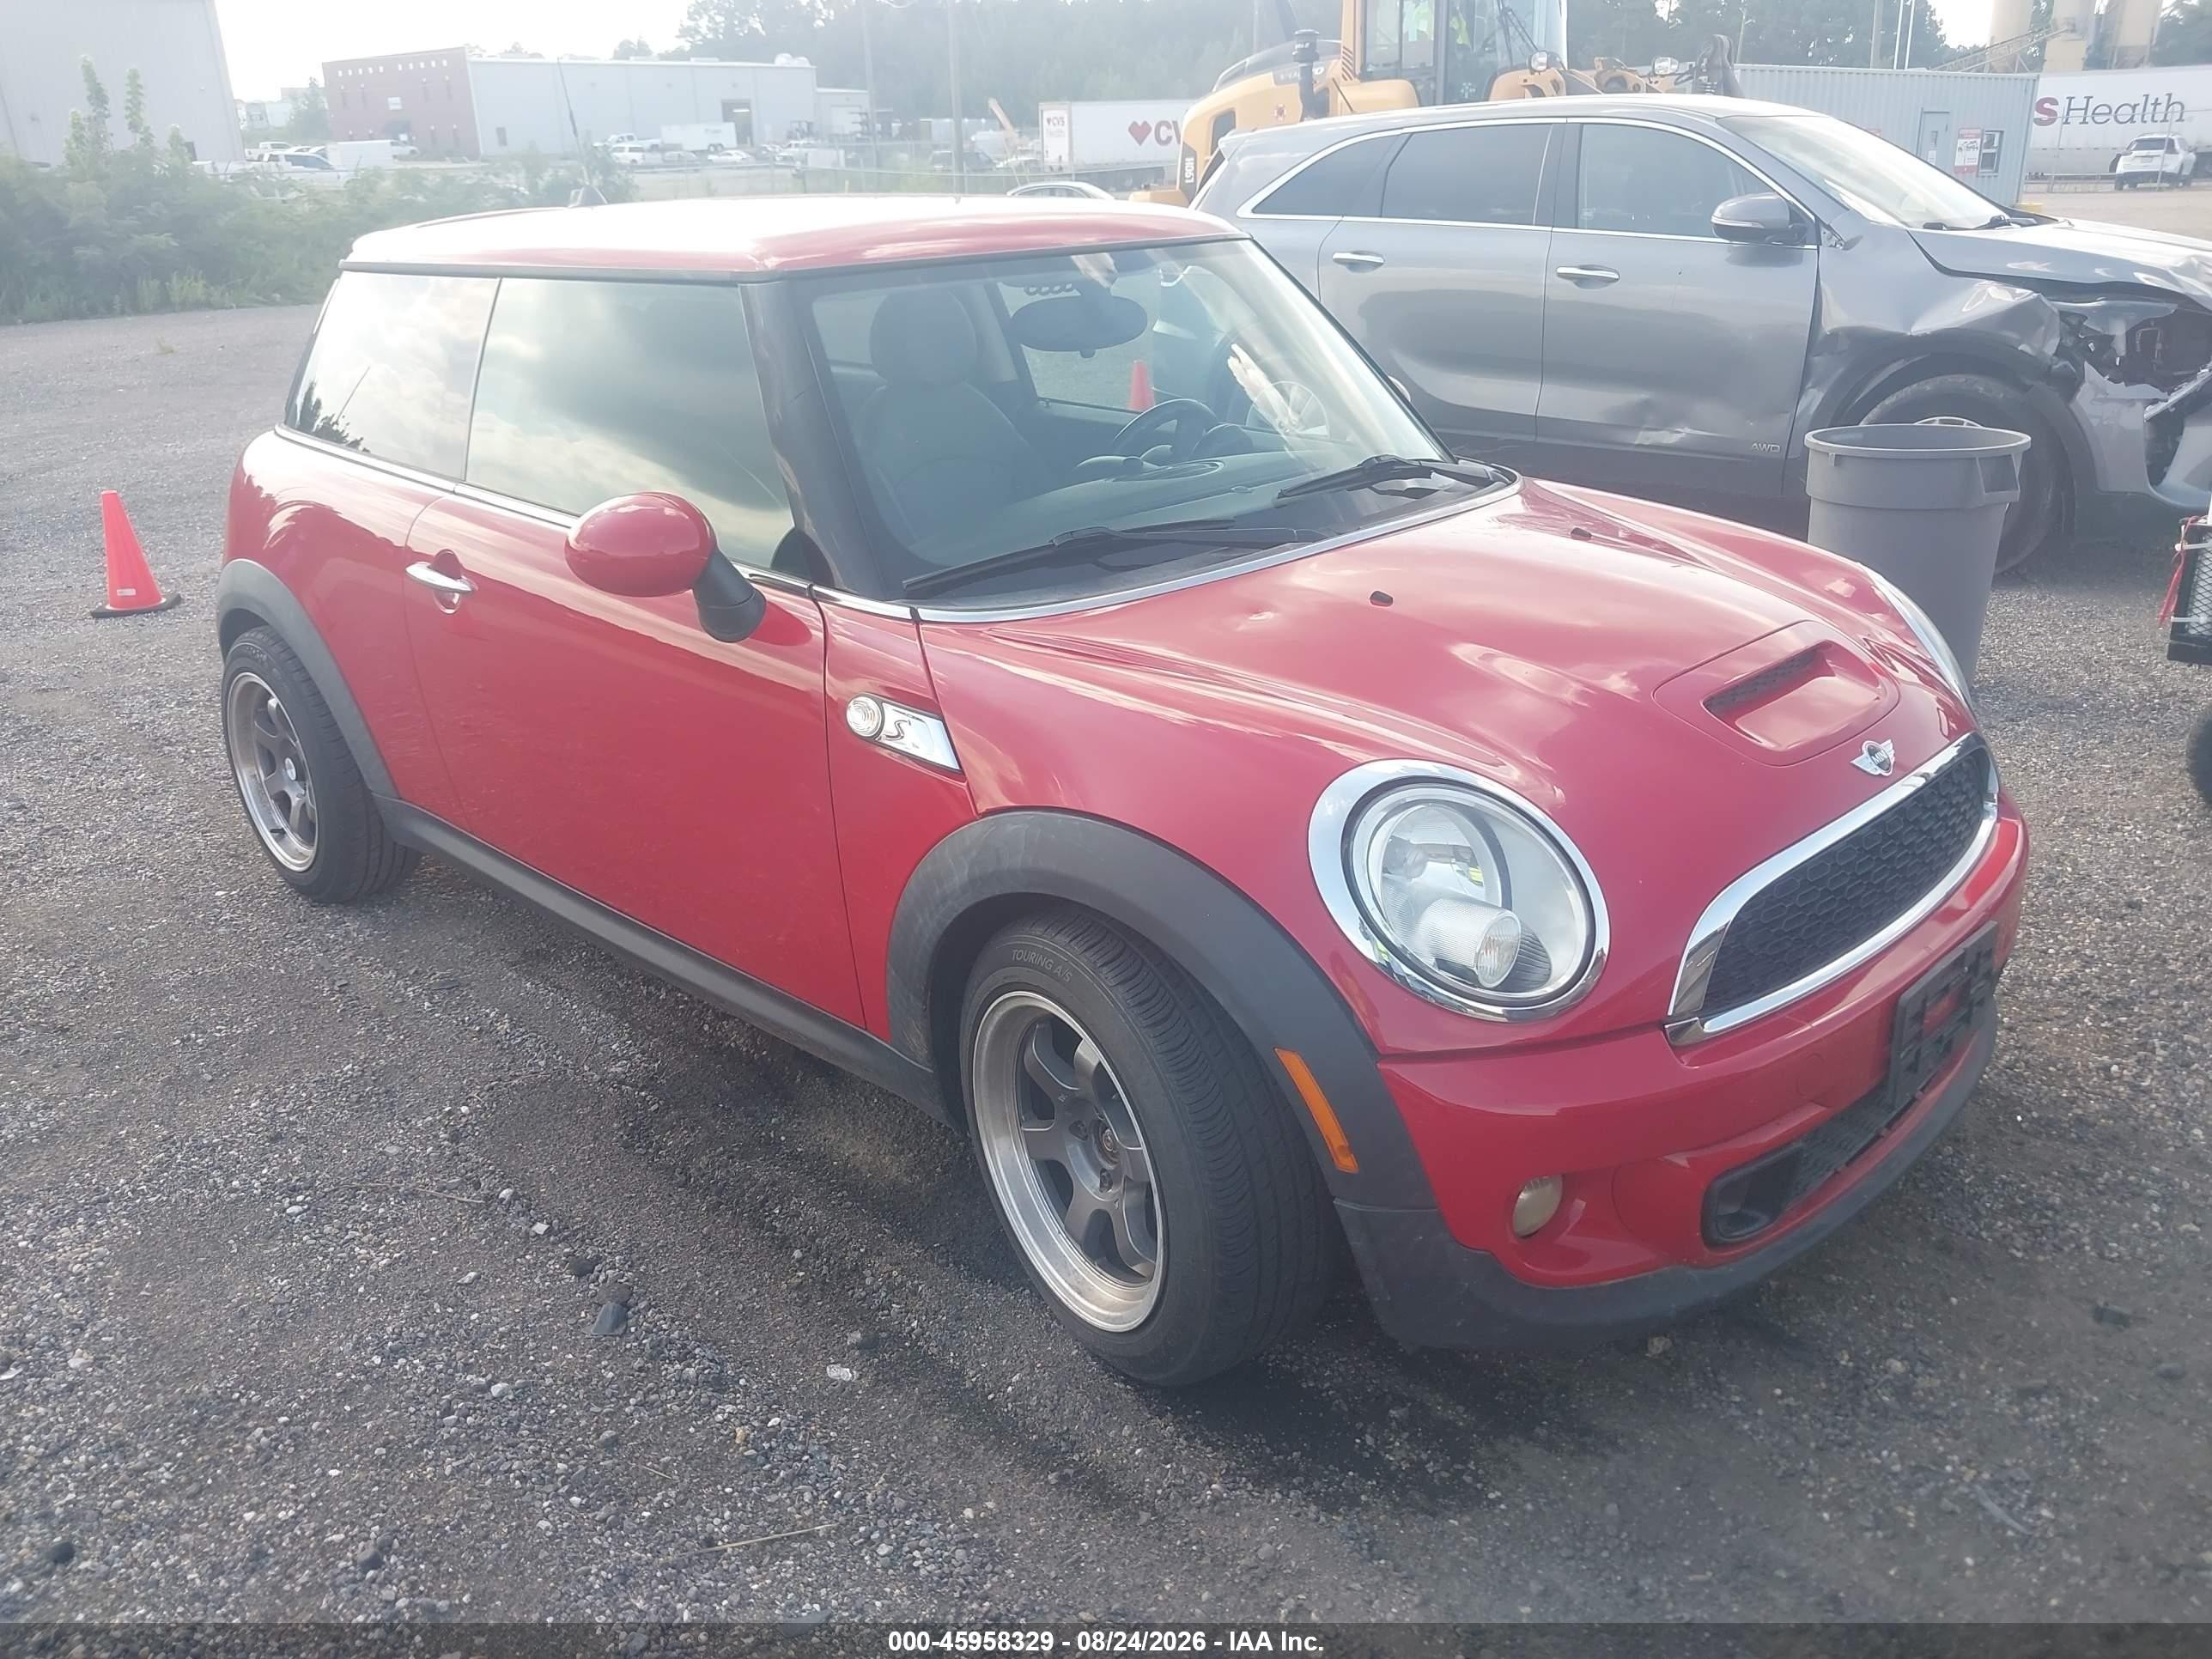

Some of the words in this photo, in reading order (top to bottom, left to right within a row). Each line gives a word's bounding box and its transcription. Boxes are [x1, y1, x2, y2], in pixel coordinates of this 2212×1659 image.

[2033, 96, 2059, 126] S
[2063, 92, 2185, 125] Health
[1184, 157, 1195, 184] L90H
[1752, 442, 1781, 453] AWD
[881, 719, 912, 741] S
[1012, 949, 1054, 970] TOURING
[1054, 964, 1073, 983] A/S
